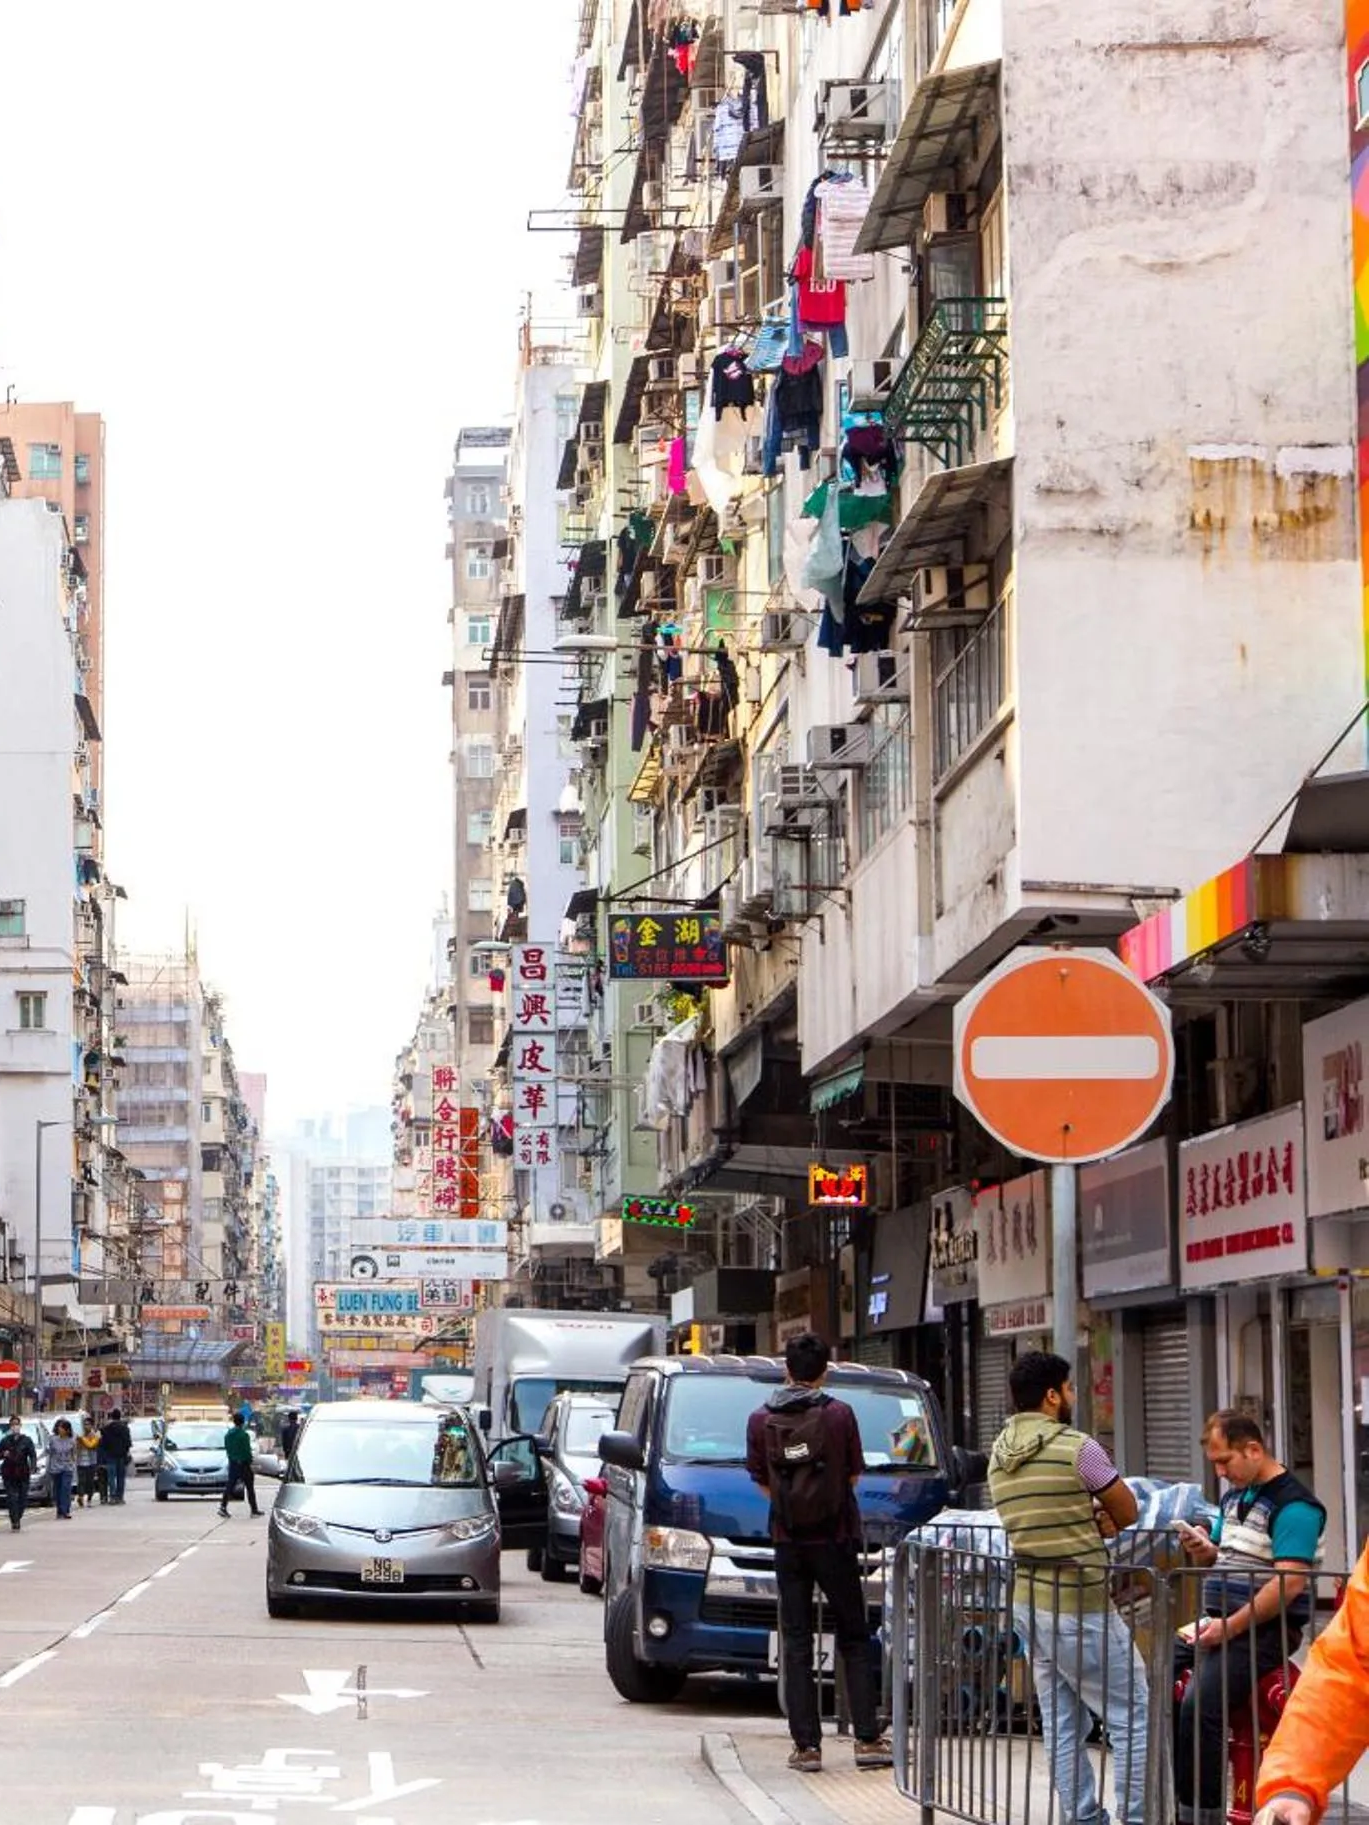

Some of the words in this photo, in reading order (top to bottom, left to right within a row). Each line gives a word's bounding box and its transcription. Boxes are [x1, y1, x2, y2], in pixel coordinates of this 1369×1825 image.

[636, 916, 700, 947] 金湖
[516, 948, 551, 1121] 昌興皮革
[519, 1130, 551, 1165] 有限公司
[338, 1291, 368, 1311] LUEN
[371, 1291, 403, 1311] FUNG
[364, 1569, 402, 1582] 2298
[373, 1557, 392, 1570] NG
